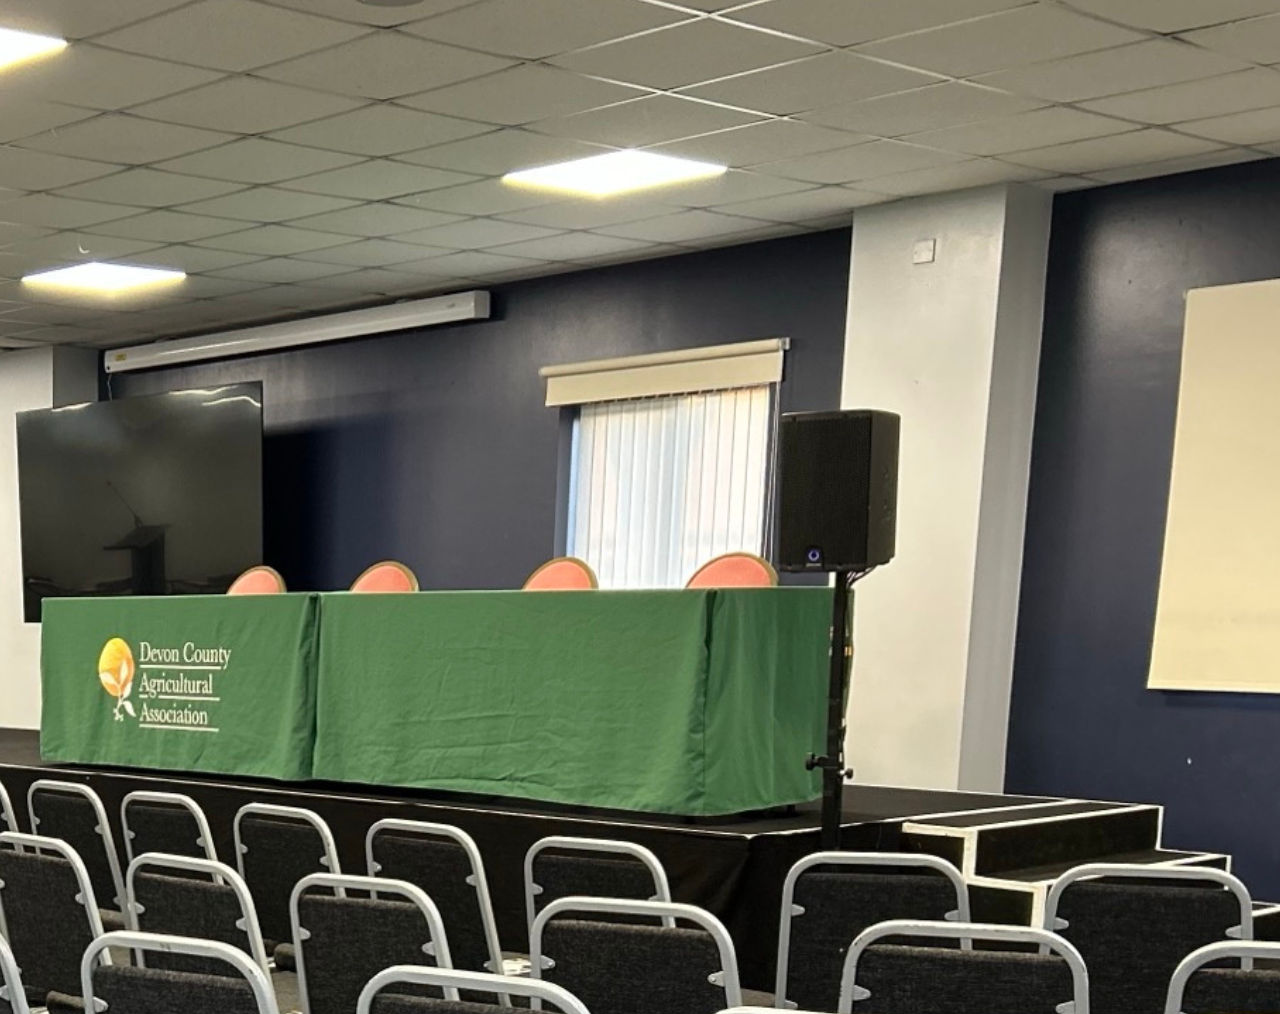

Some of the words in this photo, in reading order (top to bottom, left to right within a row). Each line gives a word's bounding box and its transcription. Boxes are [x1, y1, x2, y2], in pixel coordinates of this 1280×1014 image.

[139, 641, 179, 662] Devon
[183, 641, 232, 670] County
[138, 672, 213, 698] Agricultural
[139, 702, 208, 725] Association
